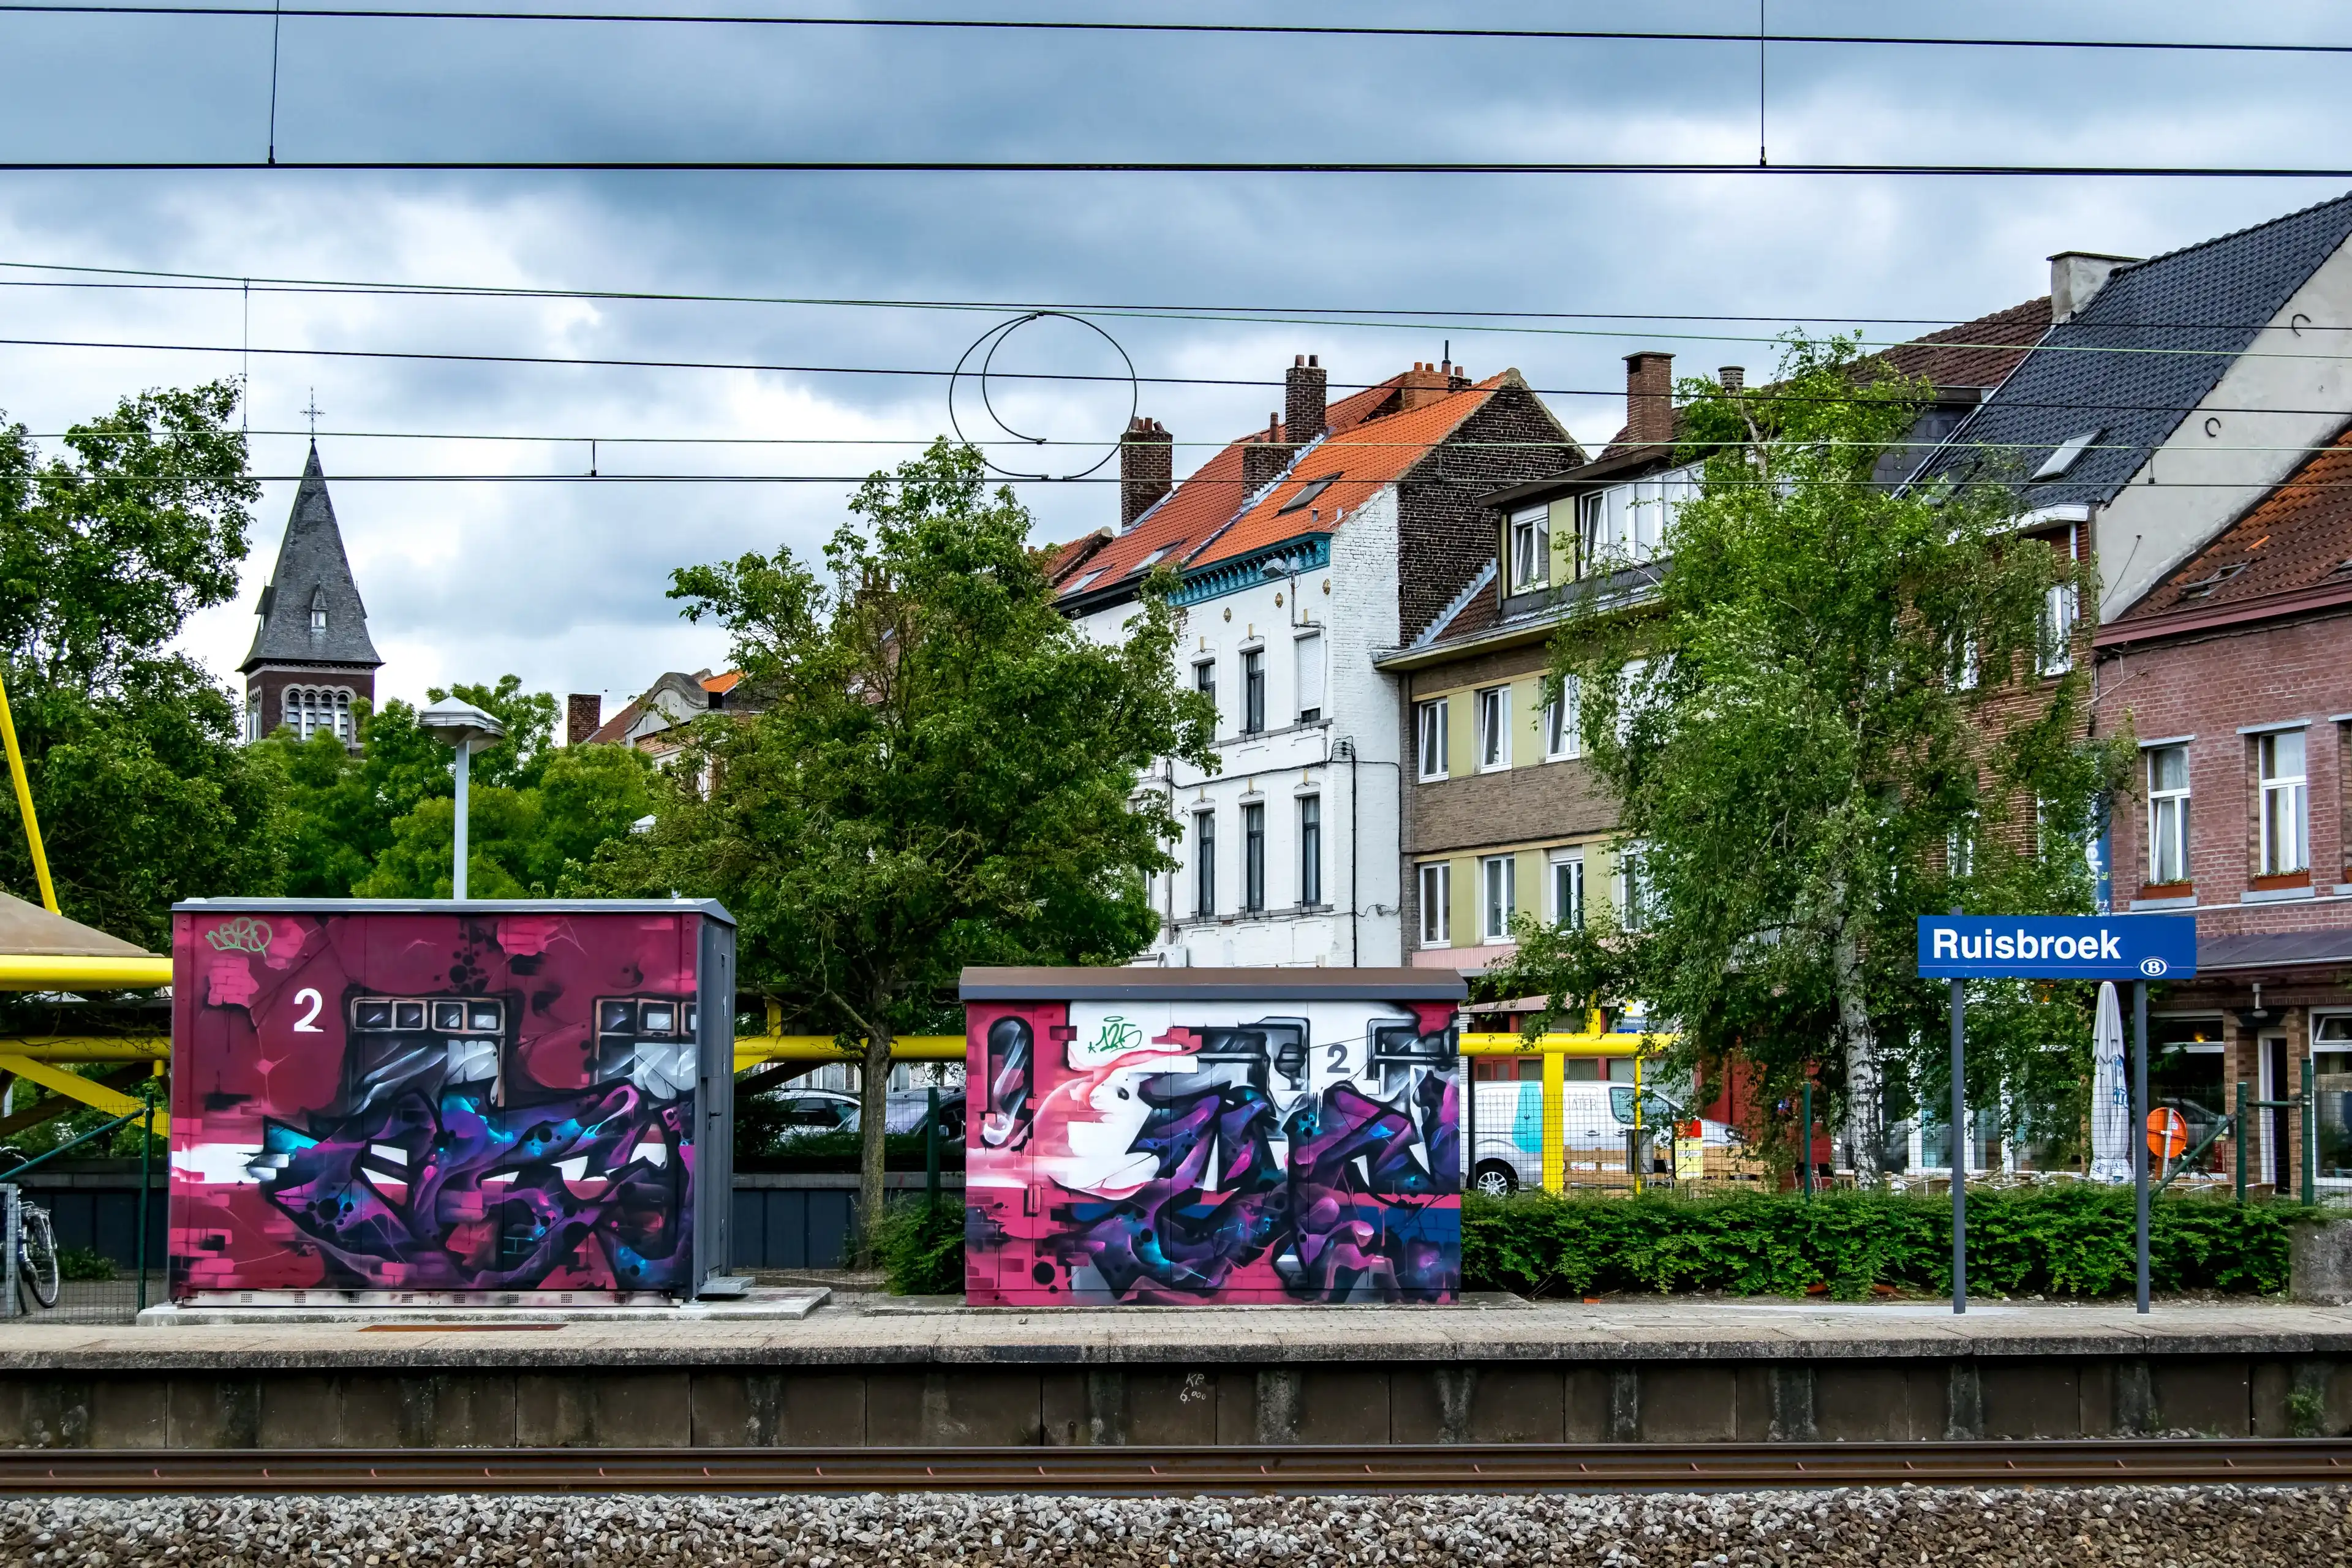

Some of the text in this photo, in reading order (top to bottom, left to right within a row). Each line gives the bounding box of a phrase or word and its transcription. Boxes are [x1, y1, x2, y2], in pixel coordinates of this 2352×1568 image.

[1934, 929, 2122, 959] Ruisbroek
[294, 988, 324, 1032] 2
[1327, 1044, 1351, 1073] 2
